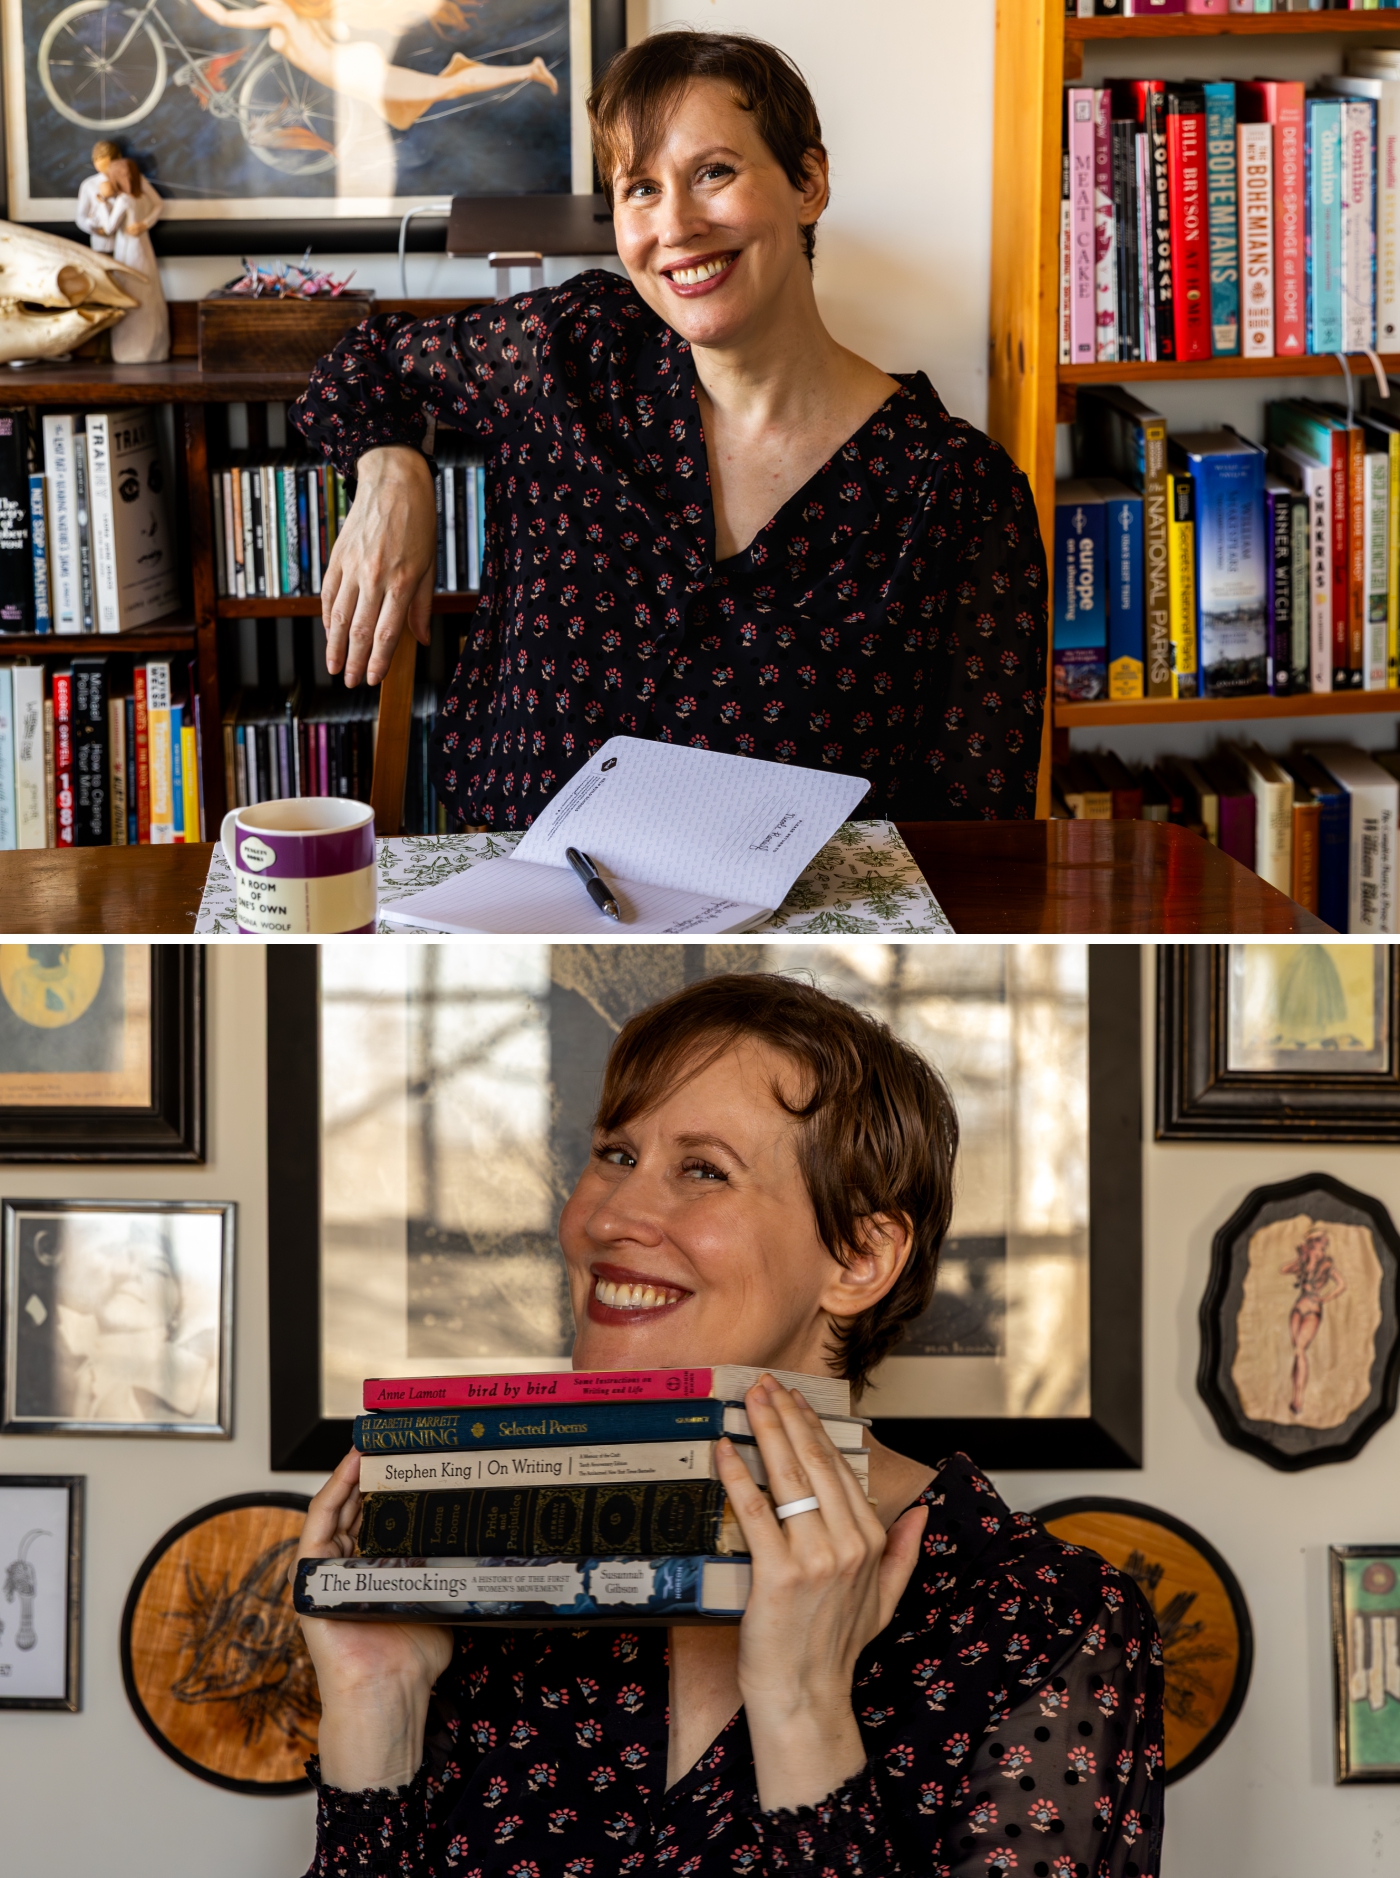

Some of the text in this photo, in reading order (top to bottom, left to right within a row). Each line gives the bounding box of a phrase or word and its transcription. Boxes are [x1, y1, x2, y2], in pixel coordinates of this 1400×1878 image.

[1096, 145, 1107, 165] TO
[1182, 119, 1197, 162] BILL
[1096, 173, 1107, 192] BE
[1320, 129, 1337, 205] domino
[1351, 129, 1368, 204] domino
[1154, 133, 1172, 302] WONDER WOMAN
[1182, 167, 1200, 241] BRYSON
[1208, 140, 1236, 283] BOHEMIANS
[1246, 164, 1269, 278] BOHEMIANS
[1075, 155, 1091, 299] MEAT CAKE
[1383, 242, 1396, 305] SECRETS
[1283, 279, 1298, 324] HOME
[92, 422, 109, 500] TRANNY
[1274, 503, 1290, 559] INNER
[1314, 485, 1326, 588] CHAKRAS
[31, 488, 49, 620] NEXT STOP ADVENTURE
[1077, 538, 1094, 611] europe
[1148, 495, 1170, 684] NATIONAL PARKS
[1274, 565, 1290, 622] WITCH
[77, 673, 89, 711] Pollan
[90, 672, 102, 721] Michael
[151, 666, 159, 708] WELSH
[159, 666, 167, 708] IRVINE
[57, 679, 73, 843] GEORGE ORWELL 1984
[79, 744, 91, 806] Your Mind
[154, 721, 168, 814] Trainspotting
[89, 743, 104, 836] How to Change
[790, 819, 803, 833] PLEASE
[244, 846, 268, 856] PENGUIN
[246, 854, 264, 862] BOOKS
[241, 877, 277, 892] A ROOM
[250, 891, 262, 901] OF
[259, 904, 288, 915] OWN
[1360, 881, 1380, 927] Blake
[260, 921, 292, 932] WOOLF
[377, 1386, 447, 1401] Anne Lamott
[467, 1380, 558, 1399] bird by bird
[573, 1377, 594, 1386] Some
[595, 1376, 640, 1385] Instructions
[582, 1385, 644, 1396] Writing and Life
[361, 1415, 461, 1431] ELIZABETH BARRETT
[361, 1428, 460, 1450] BROWNING
[498, 1419, 588, 1437] Selected Poems
[385, 1458, 563, 1483] Stephen King On Writing
[430, 1505, 445, 1544] Lorna
[446, 1503, 461, 1545] Doone
[485, 1506, 499, 1539] Pride
[499, 1513, 507, 1531] and
[506, 1494, 522, 1550] Prejudice
[550, 1502, 559, 1540] LIBRARY
[557, 1502, 567, 1540] EDITION
[320, 1573, 468, 1598] The Bluestockings
[477, 1585, 564, 1593] WOMEN'S MOVEMENT
[478, 1575, 514, 1583] HISTORY
[514, 1575, 527, 1583] OF
[527, 1575, 546, 1583] THE
[546, 1575, 572, 1583] FIRST
[600, 1569, 645, 1580] Susannah
[605, 1583, 639, 1594] Gibson
[674, 1566, 684, 1599] NORTON
